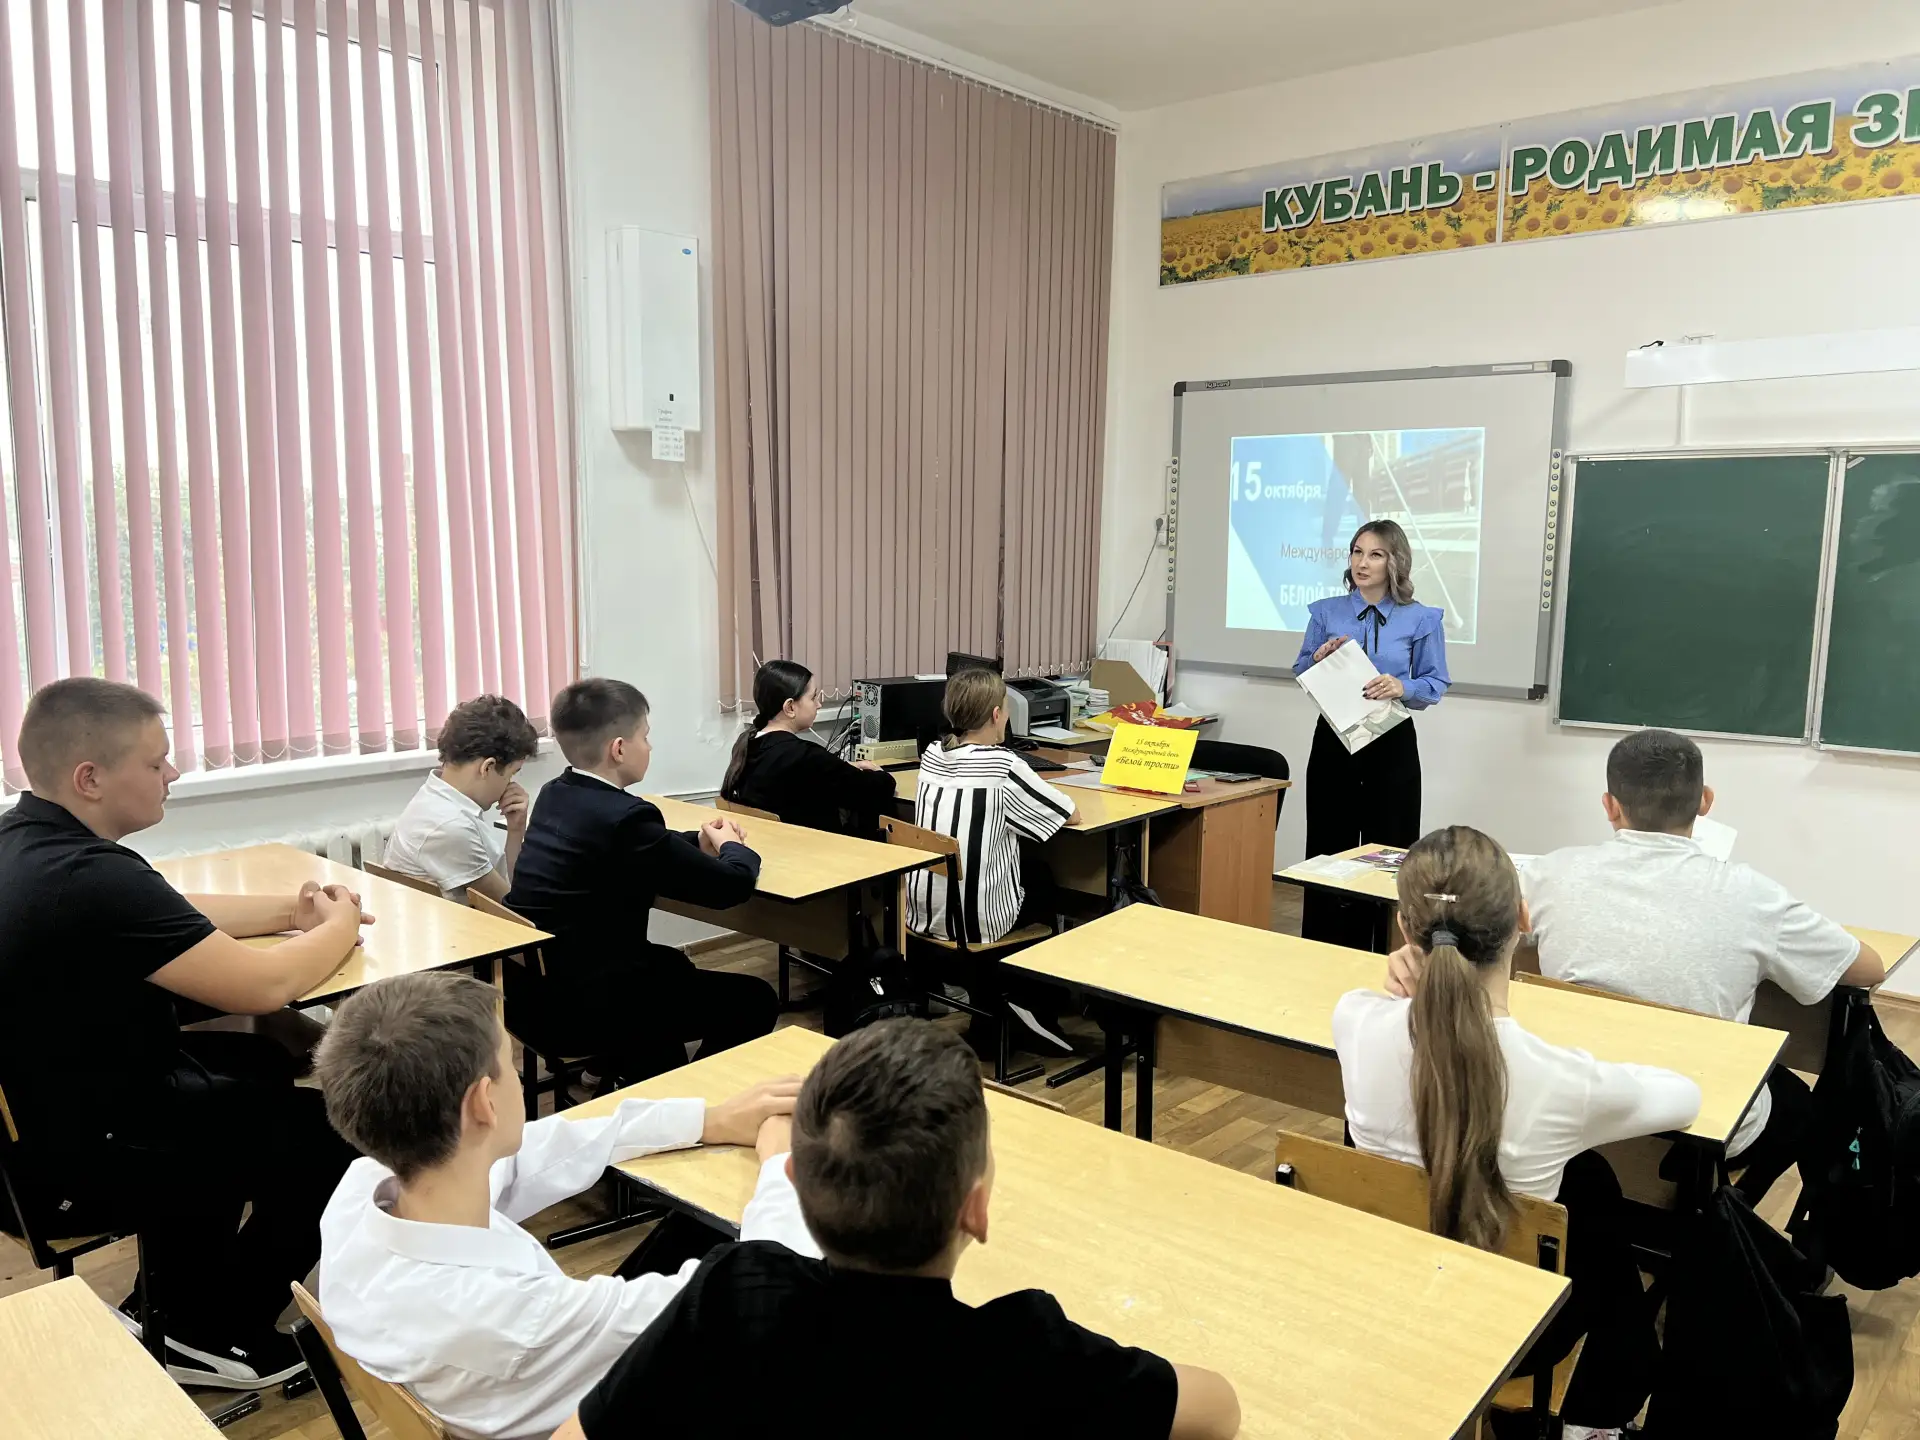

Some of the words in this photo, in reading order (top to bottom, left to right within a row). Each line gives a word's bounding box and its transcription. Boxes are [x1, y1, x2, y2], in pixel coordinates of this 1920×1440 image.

[1262, 160, 1463, 232] КУБАНЬ
[1508, 98, 1835, 195] РОДИМАЯ
[1231, 461, 1262, 502] 15
[1280, 543, 1349, 563] Междунаро
[1280, 582, 1324, 606] БЕЛОЙ
[1122, 746, 1166, 757] Международный
[1136, 738, 1144, 746] 15
[1144, 740, 1171, 749] октября
[1115, 756, 1143, 766] «Белой
[1143, 760, 1180, 770] трости»
